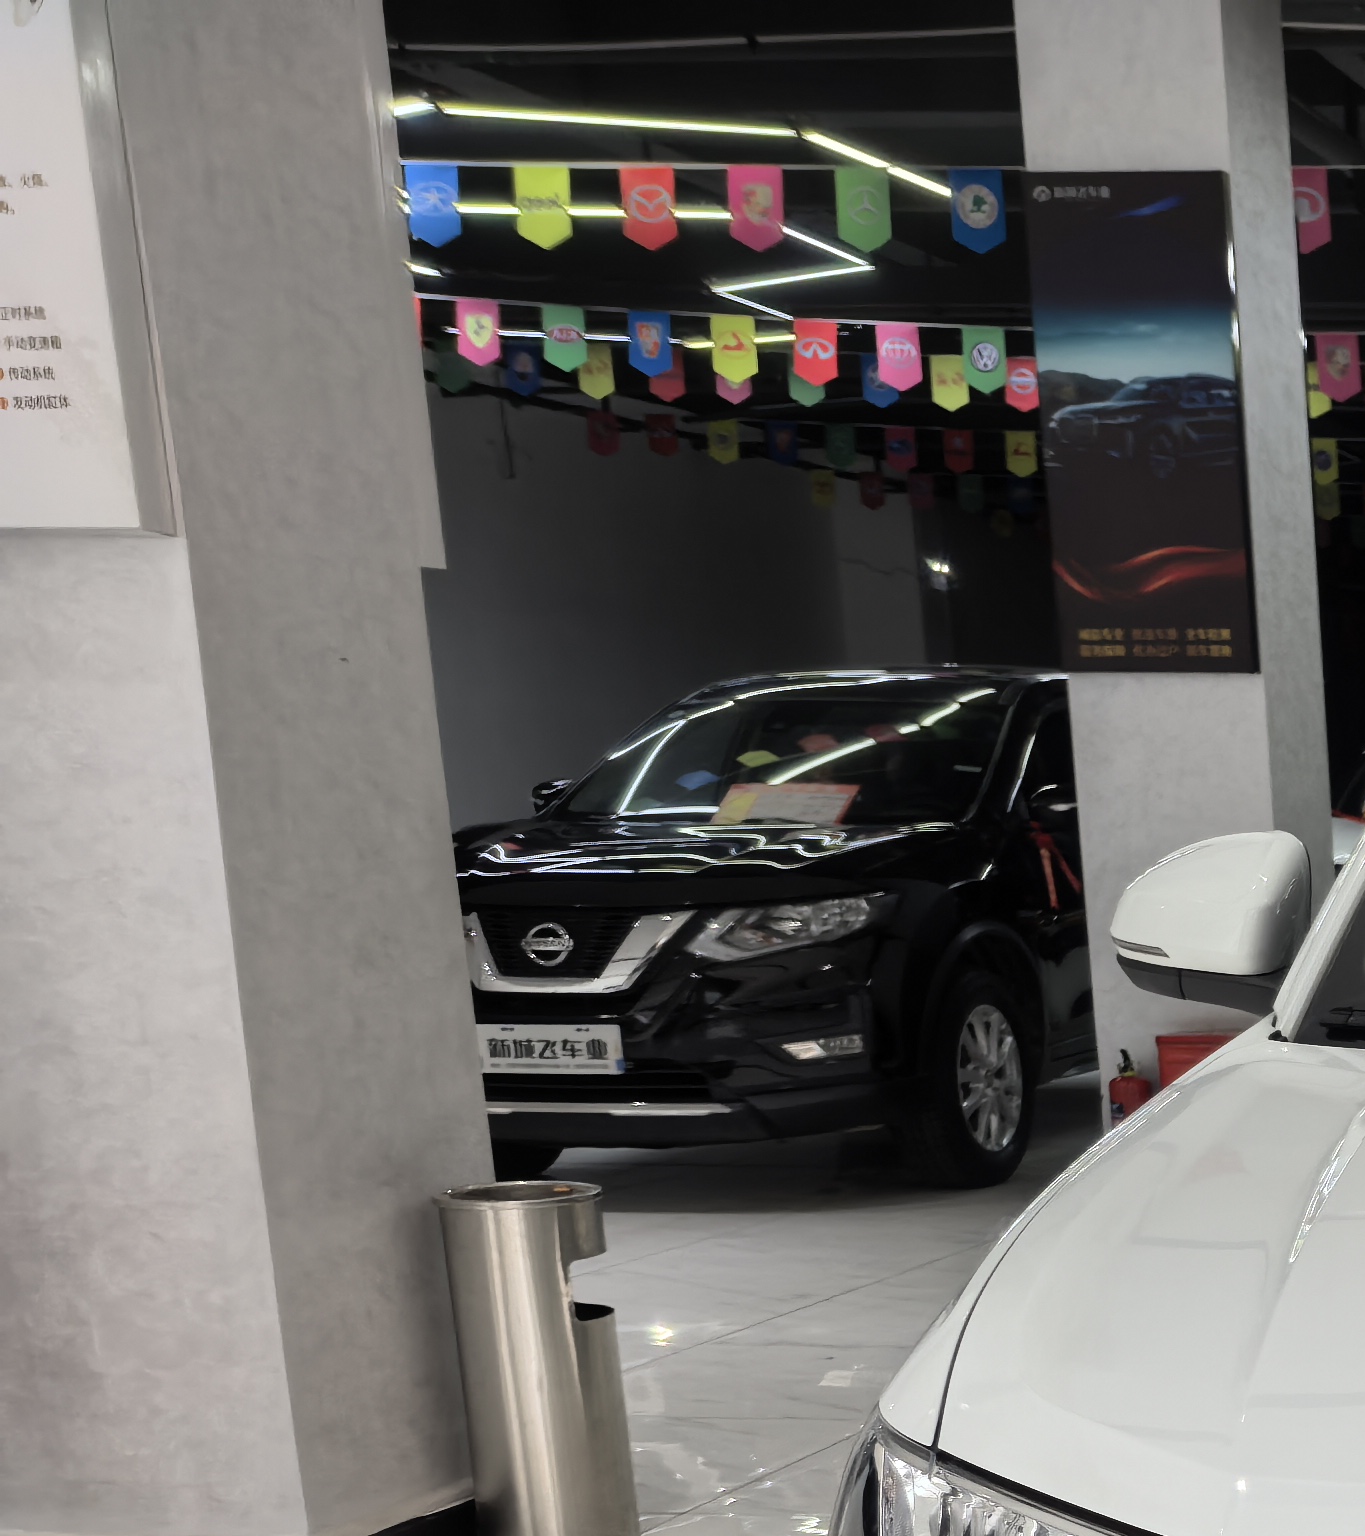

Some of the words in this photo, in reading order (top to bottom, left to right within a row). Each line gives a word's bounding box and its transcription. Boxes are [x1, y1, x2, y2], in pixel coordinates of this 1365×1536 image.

[487, 1038, 609, 1060] 新城飞车业
